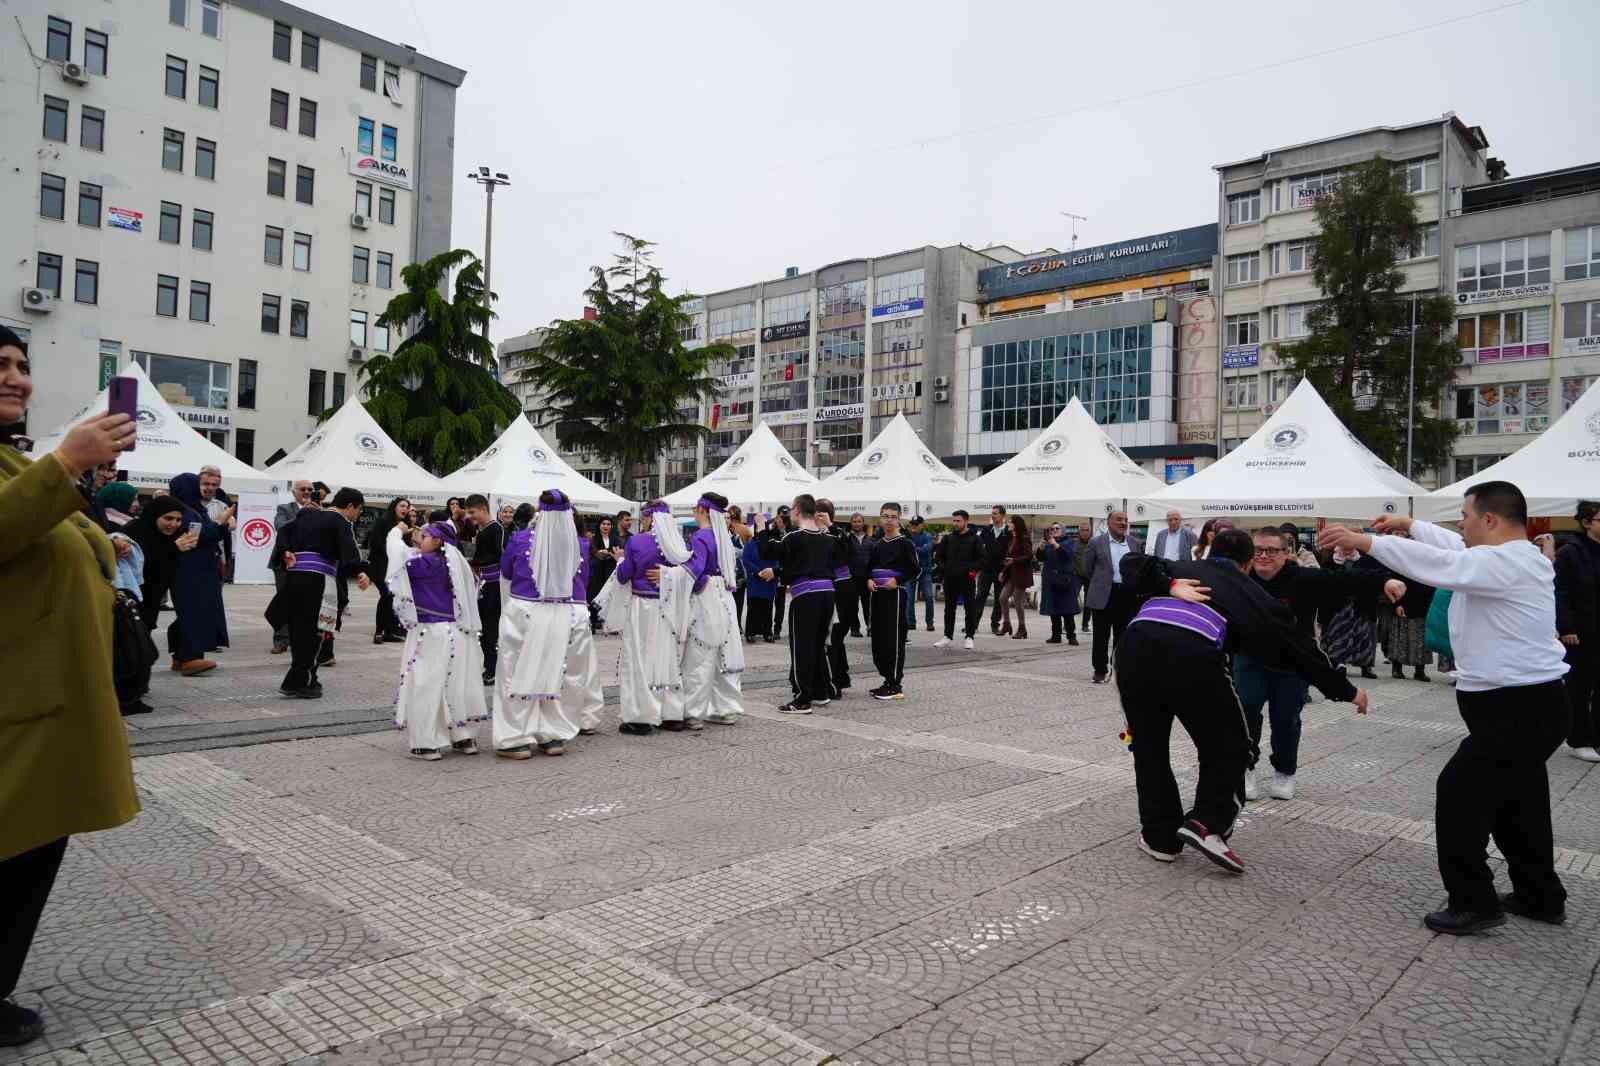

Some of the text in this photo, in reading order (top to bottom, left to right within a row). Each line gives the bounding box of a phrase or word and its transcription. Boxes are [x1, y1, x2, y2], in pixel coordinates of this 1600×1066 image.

[1109, 238, 1170, 258] KURUMLARI
[1181, 431, 1217, 441] URSU
[1246, 460, 1306, 469] BÜYÜKŞEHİR
[1230, 503, 1273, 512] BÜYÜKŞEHİR
